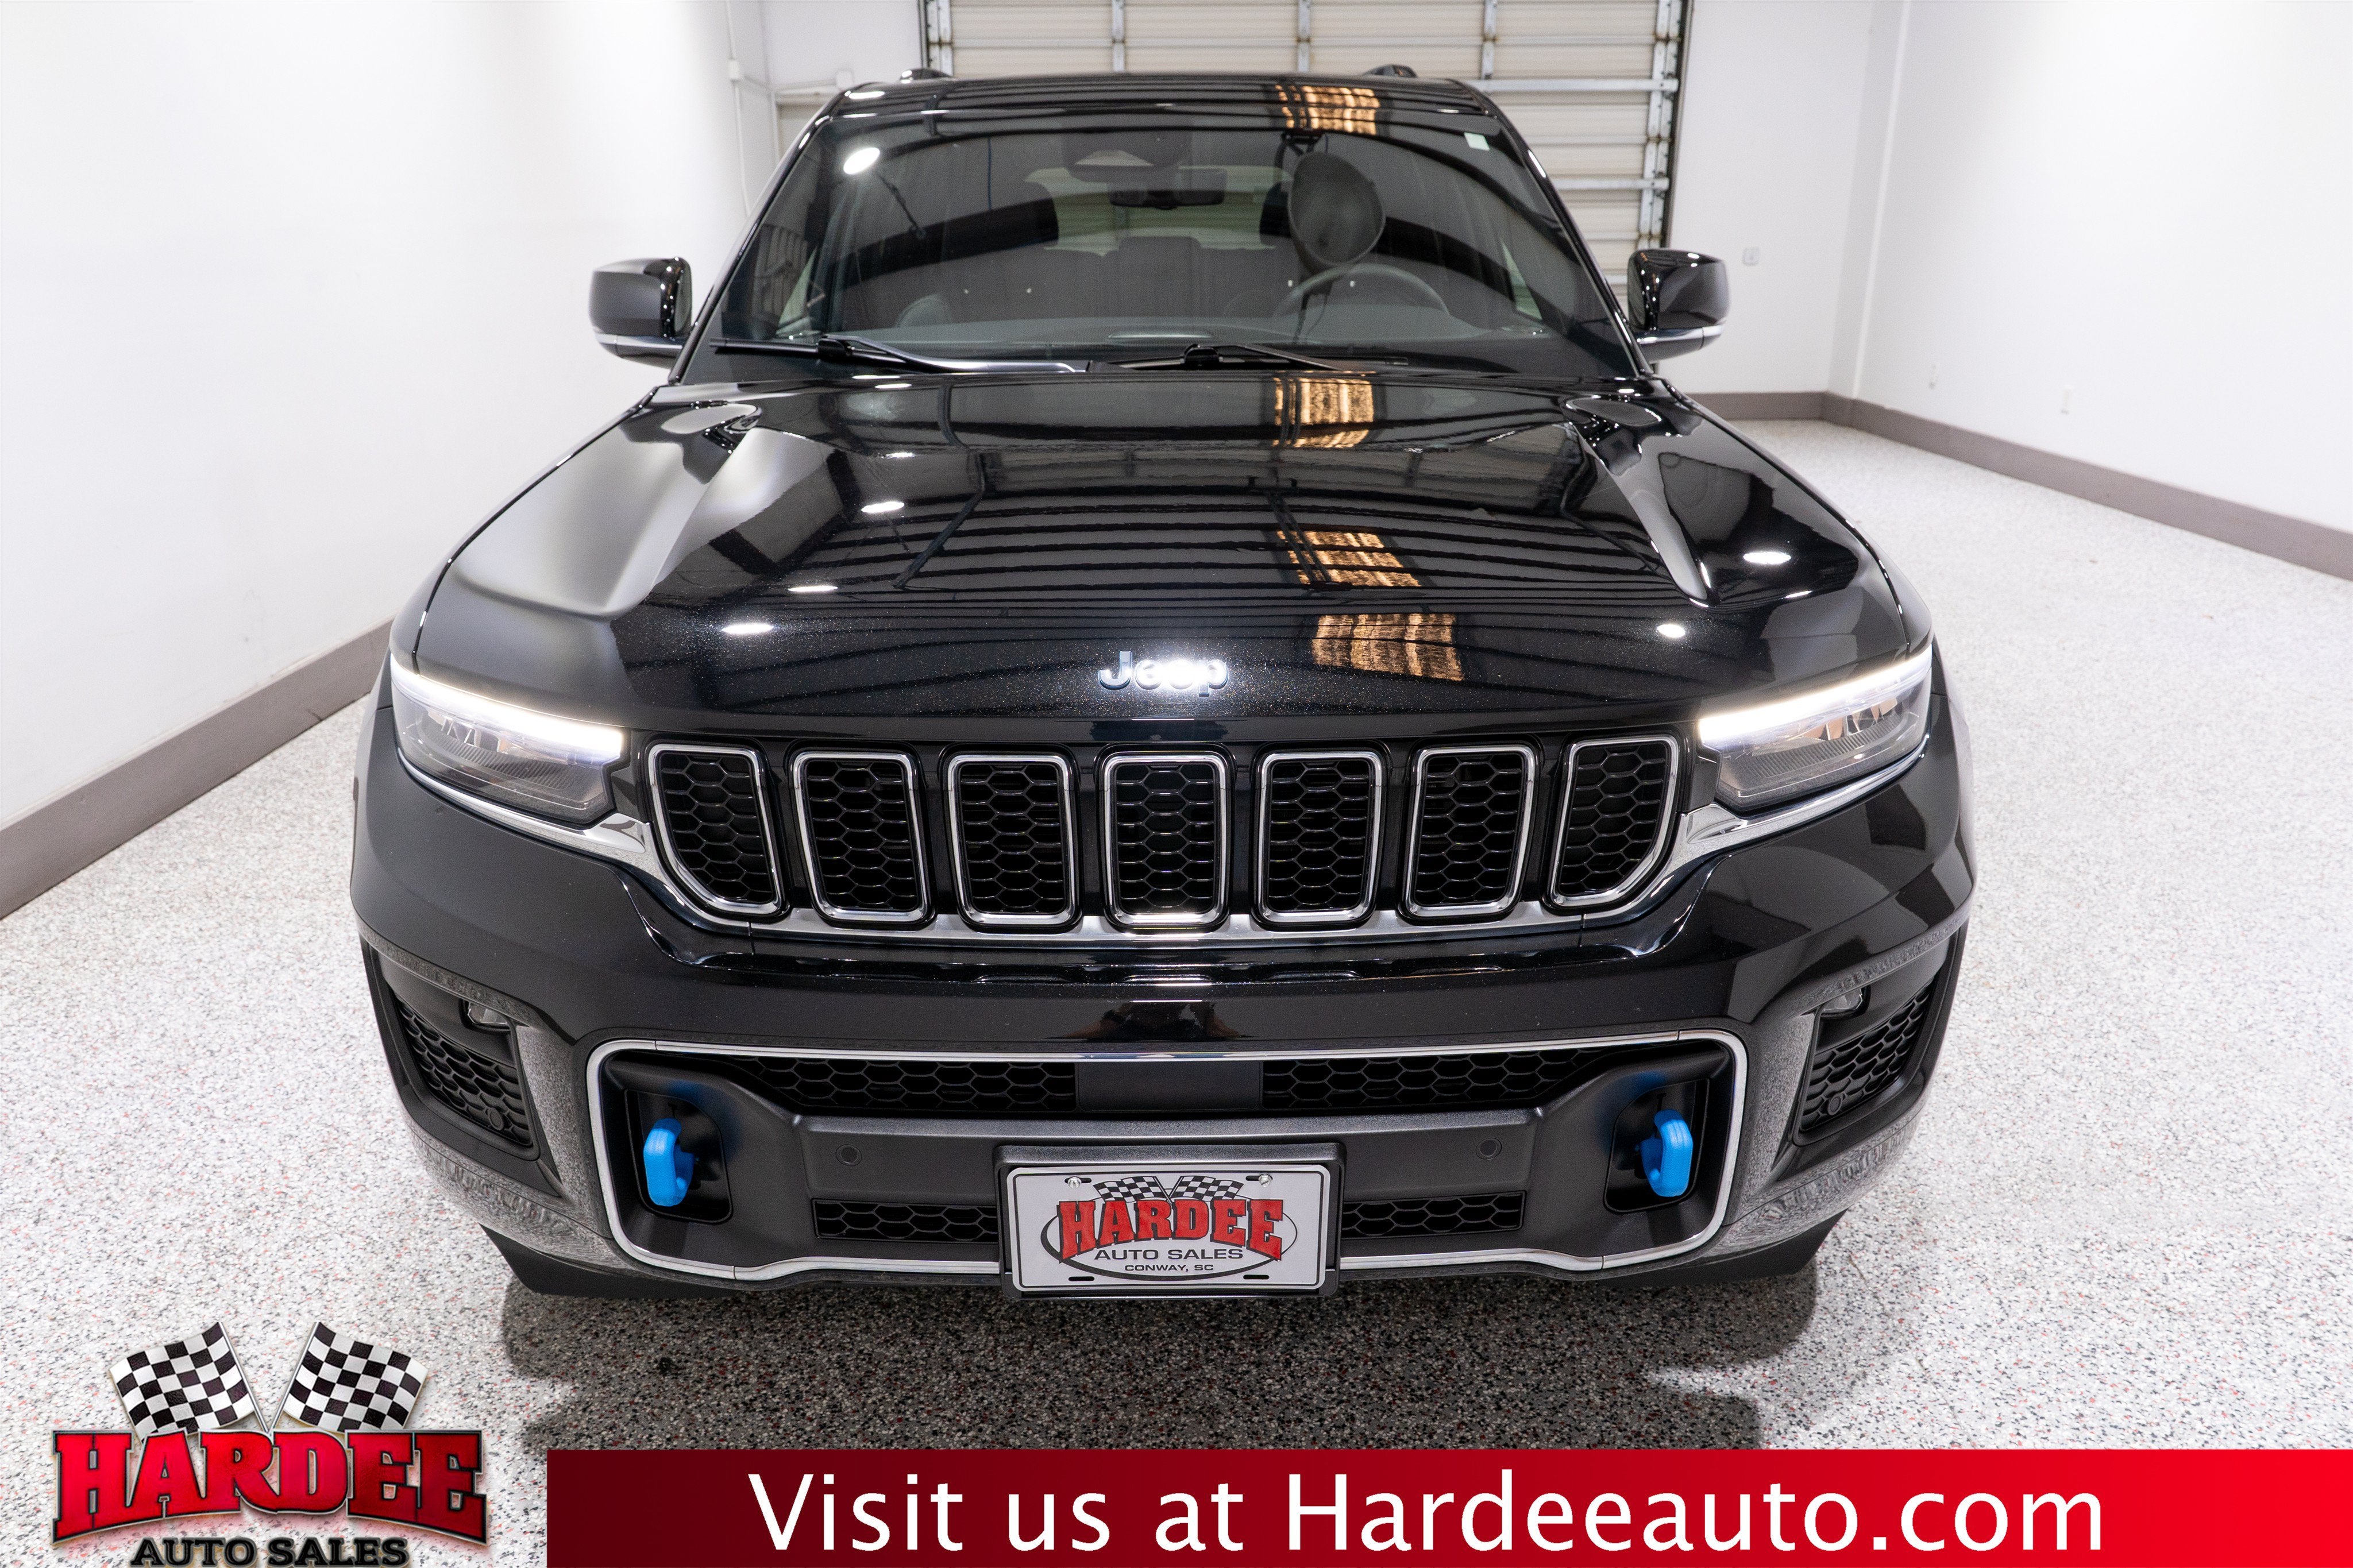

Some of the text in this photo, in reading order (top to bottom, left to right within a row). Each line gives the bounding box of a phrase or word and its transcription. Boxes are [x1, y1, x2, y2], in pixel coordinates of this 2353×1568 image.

[1056, 1199, 1284, 1263] HARDEE
[1094, 1249, 1244, 1260] AUTO SALES
[1124, 1264, 1189, 1272] CONWAY,
